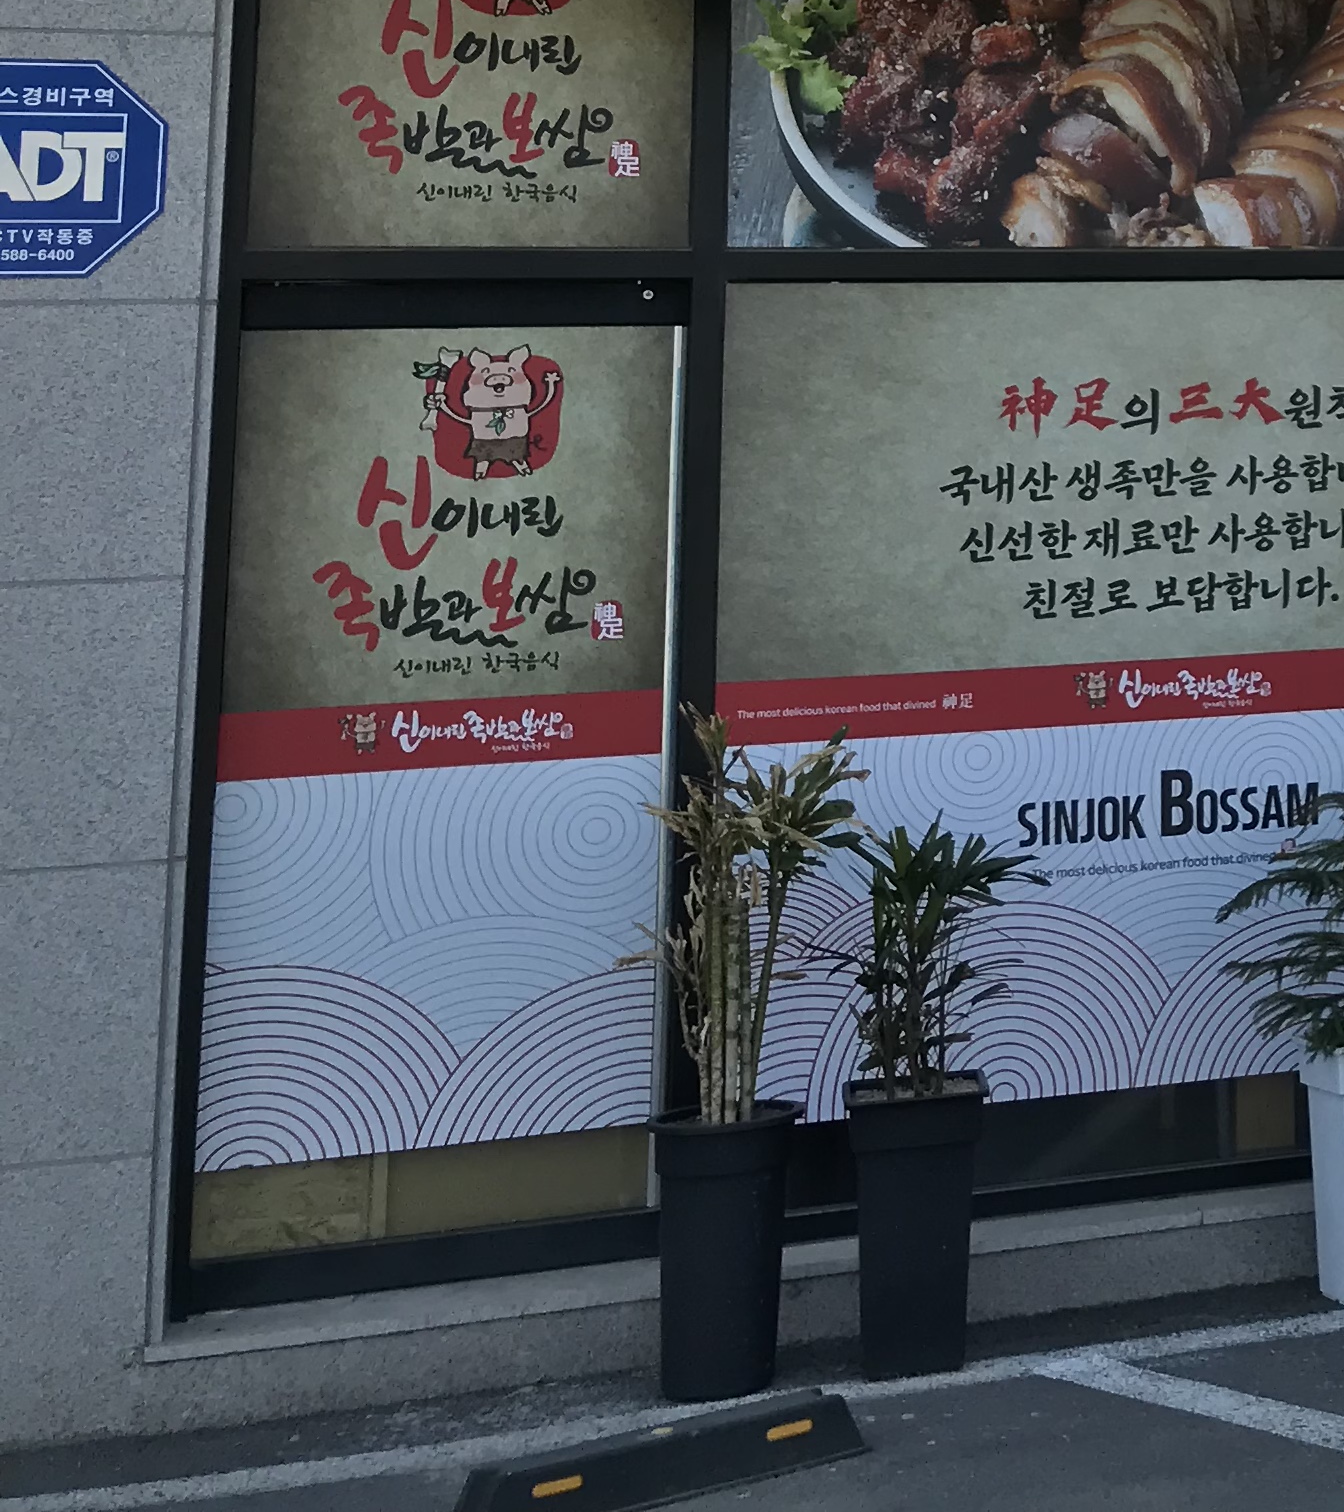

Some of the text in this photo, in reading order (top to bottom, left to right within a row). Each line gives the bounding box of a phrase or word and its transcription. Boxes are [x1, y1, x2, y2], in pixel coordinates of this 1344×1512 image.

[416, 182, 578, 203] 신이내린 한국음식
[0, 228, 94, 245] TV작동중
[1, 249, 75, 261] 588-6400
[939, 461, 1059, 506] 국내산
[1065, 456, 1218, 503] 생족만을
[959, 517, 1078, 563] 신선한
[1082, 514, 1201, 559] 재료만
[1023, 565, 1340, 620] 친절로 보답합니다.
[393, 651, 560, 679] 신이내린 한국음식
[737, 710, 755, 719] The
[757, 708, 781, 718] most
[782, 706, 824, 717] delicious
[825, 704, 858, 714] korean
[859, 702, 881, 712] food
[883, 701, 902, 711] that
[903, 699, 937, 710] divined
[1017, 794, 1147, 848] SINJOK
[1056, 867, 1086, 878] most
[1088, 862, 1138, 876] delicious
[1140, 858, 1180, 872] korean
[1182, 855, 1209, 868] food
[1211, 853, 1234, 866] that
